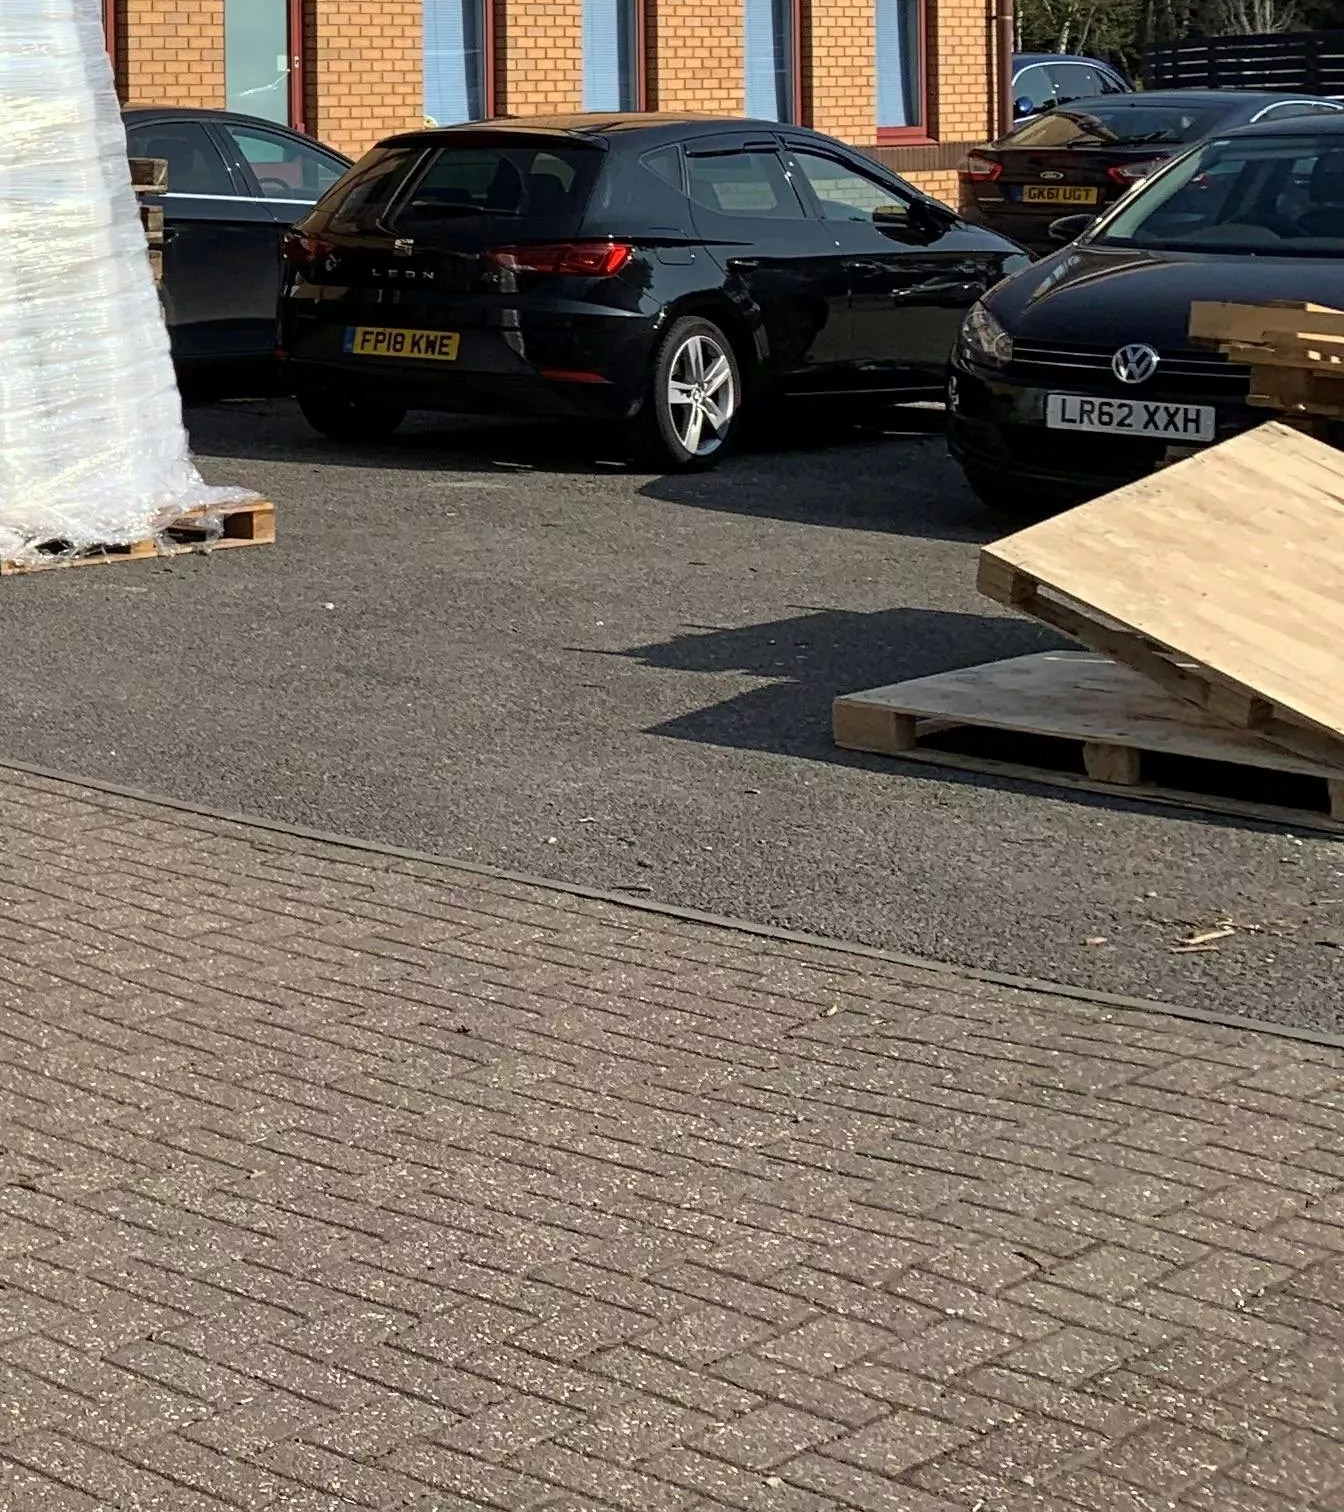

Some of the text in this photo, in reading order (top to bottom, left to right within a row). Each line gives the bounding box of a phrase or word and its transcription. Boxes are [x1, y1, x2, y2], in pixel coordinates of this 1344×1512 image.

[372, 268, 434, 279] LEON
[361, 330, 452, 356] FP18 KWE
[1061, 397, 1201, 434] LR62 XXH
